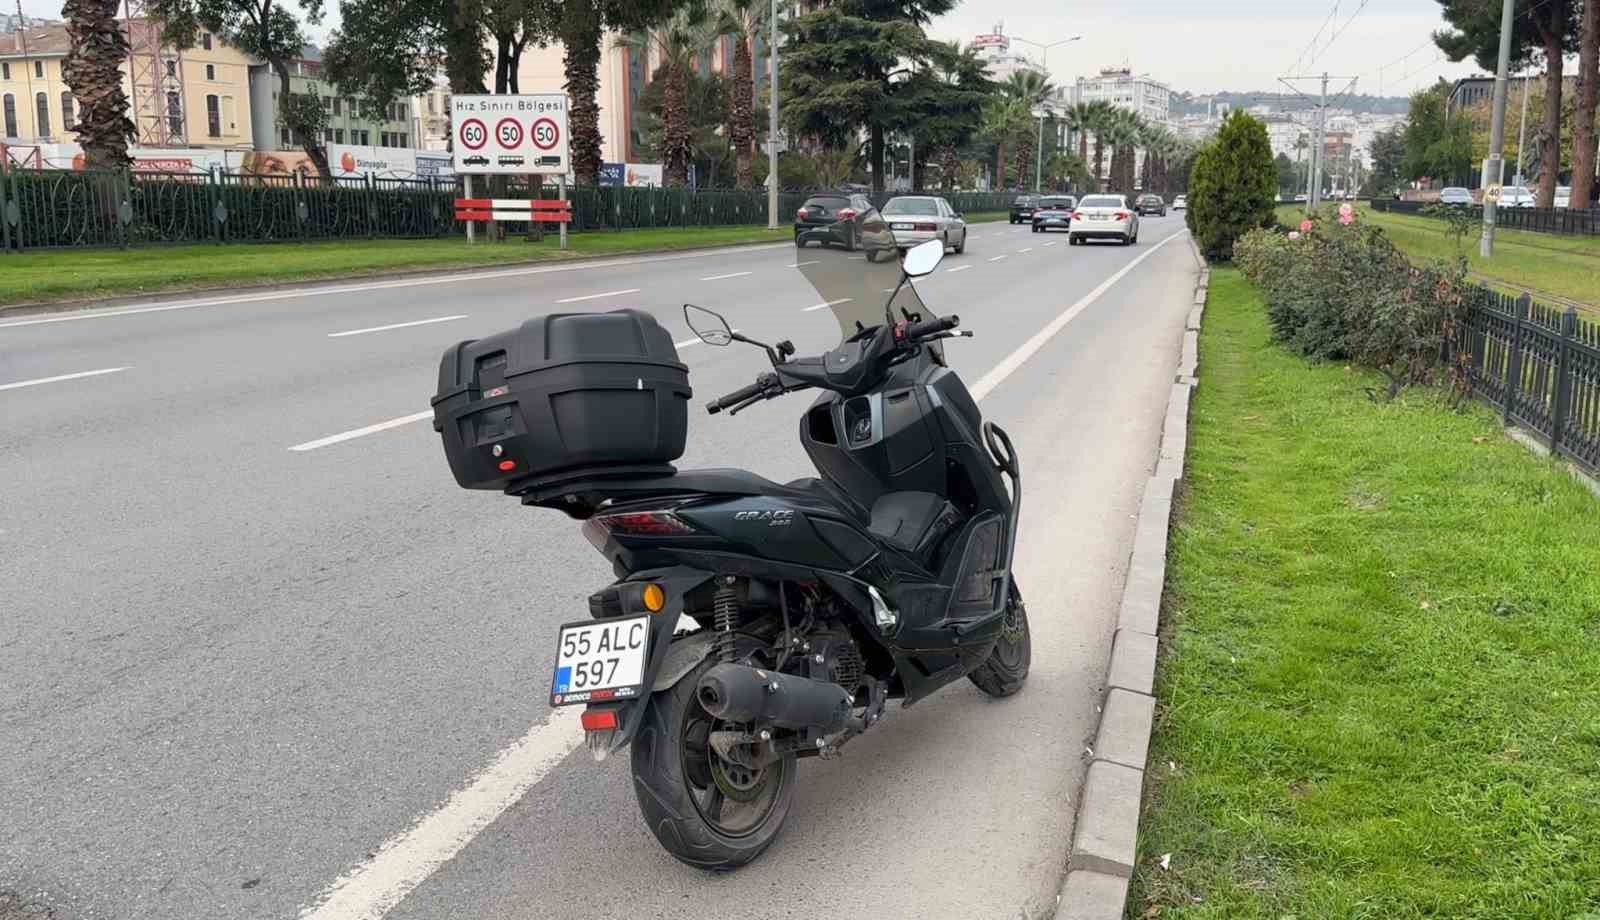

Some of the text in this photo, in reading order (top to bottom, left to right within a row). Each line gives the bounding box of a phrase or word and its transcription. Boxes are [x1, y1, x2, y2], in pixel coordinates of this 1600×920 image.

[456, 101, 563, 113] Hız Sınırı Bölgesi
[465, 127, 482, 142] 60
[502, 127, 519, 142] 50
[536, 127, 554, 142] 50
[1489, 188, 1500, 196] 40
[734, 510, 794, 520] GRACE
[563, 623, 643, 658] 55 ALC
[575, 658, 620, 688] 597
